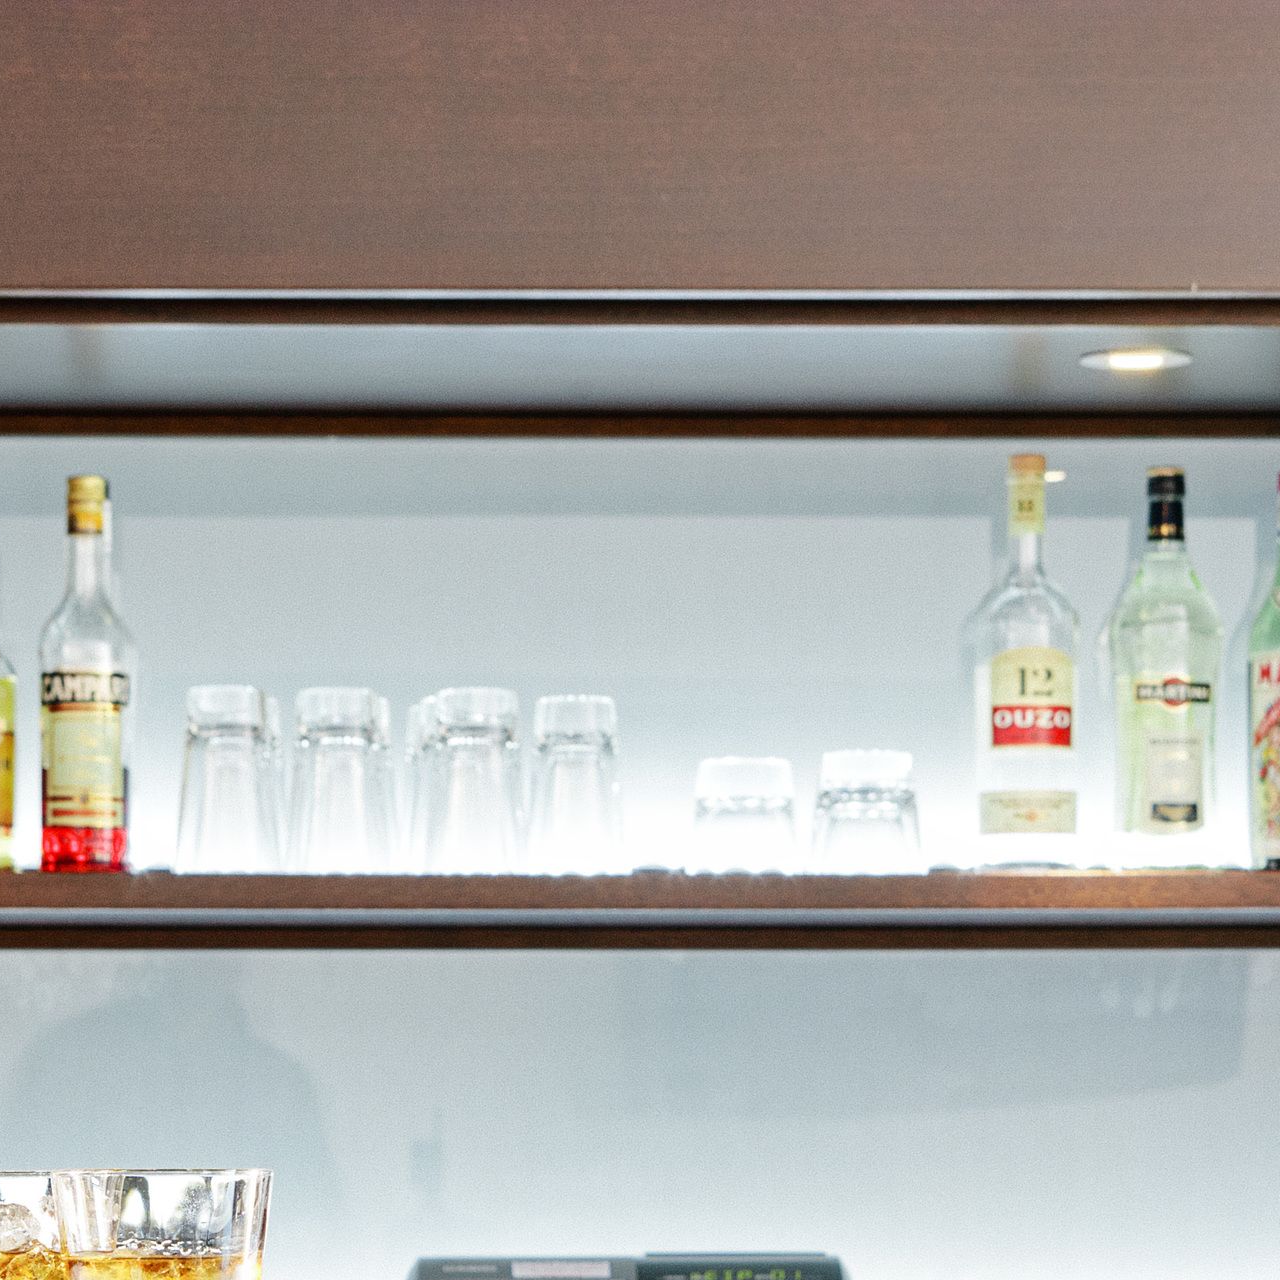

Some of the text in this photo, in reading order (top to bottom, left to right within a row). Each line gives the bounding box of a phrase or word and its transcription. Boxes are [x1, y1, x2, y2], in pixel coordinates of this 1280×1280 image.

[1018, 667, 1054, 697] 12
[1137, 684, 1210, 700] MARTINI
[993, 708, 1071, 730] OUZO
